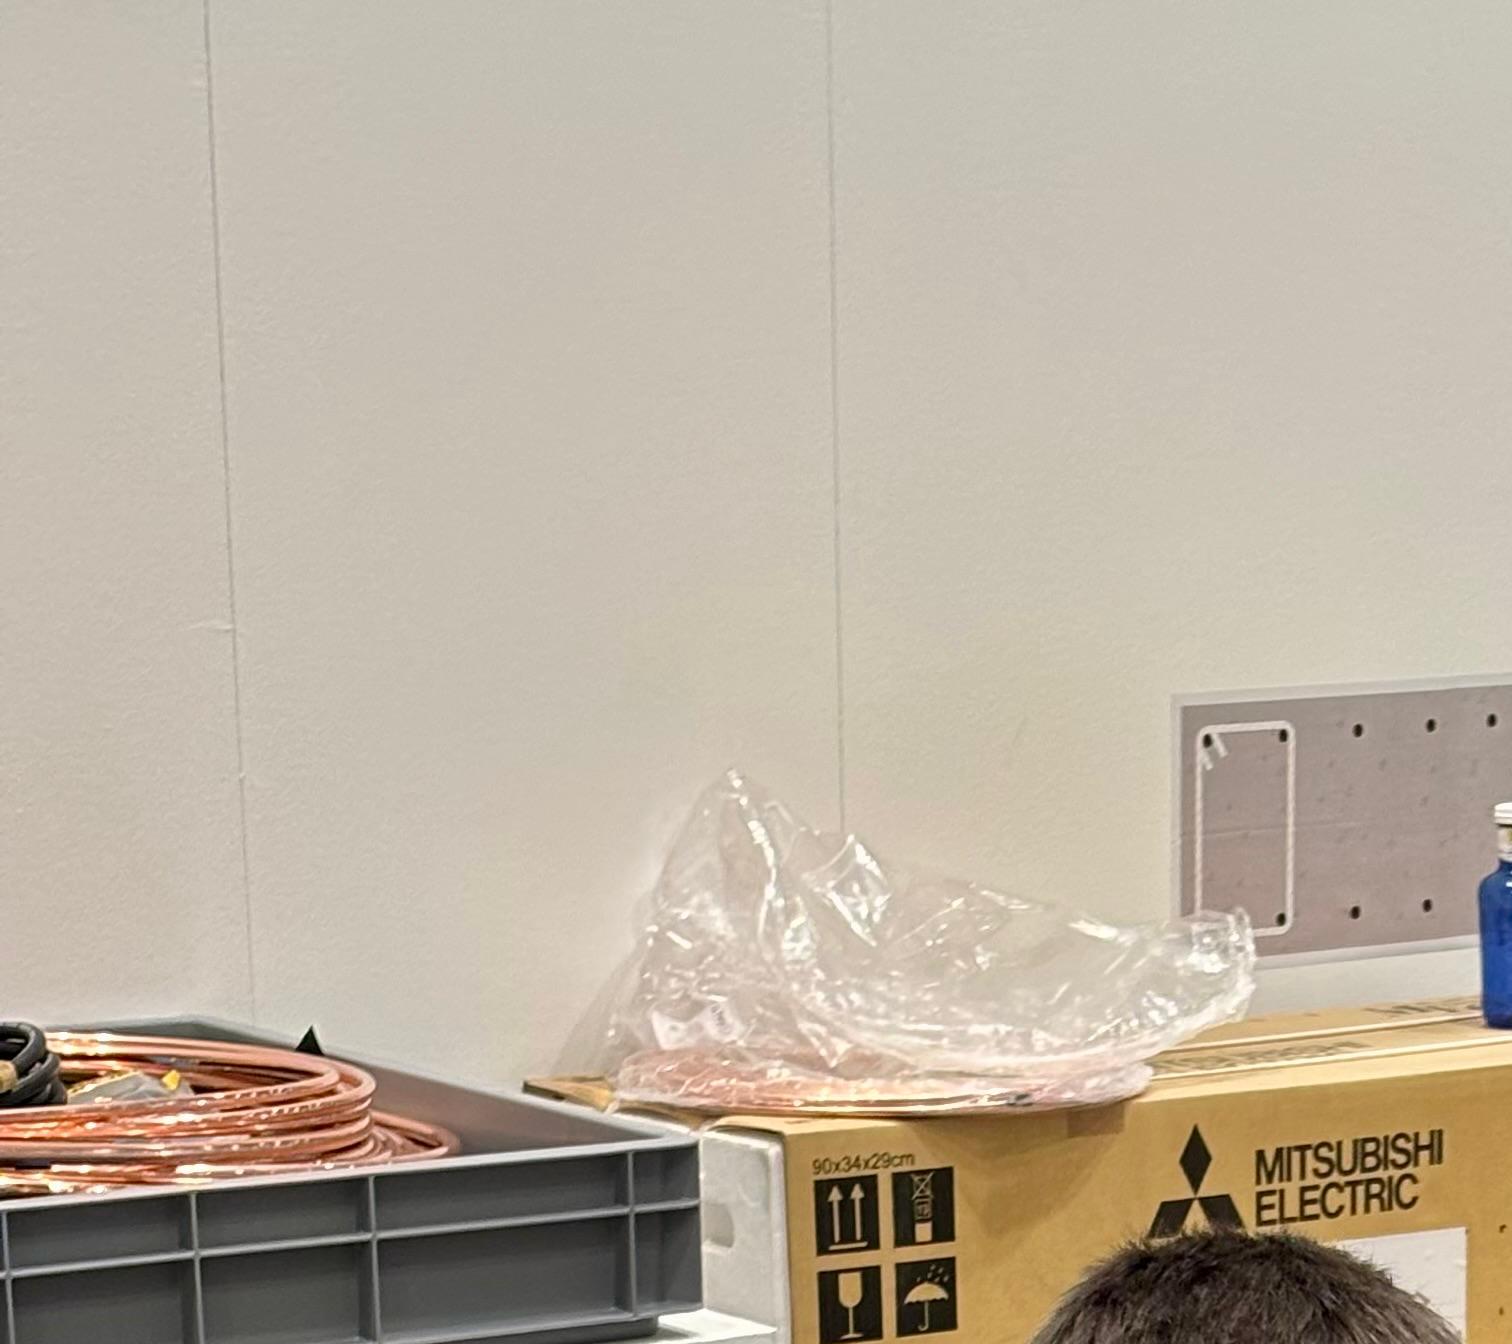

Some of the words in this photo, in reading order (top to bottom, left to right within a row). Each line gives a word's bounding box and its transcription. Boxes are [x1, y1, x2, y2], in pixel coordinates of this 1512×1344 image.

[812, 1151, 916, 1175] 90x34x29cm
[1254, 1128, 1444, 1186] MITSUBISHI
[1255, 1172, 1420, 1227] ELECTRIC
